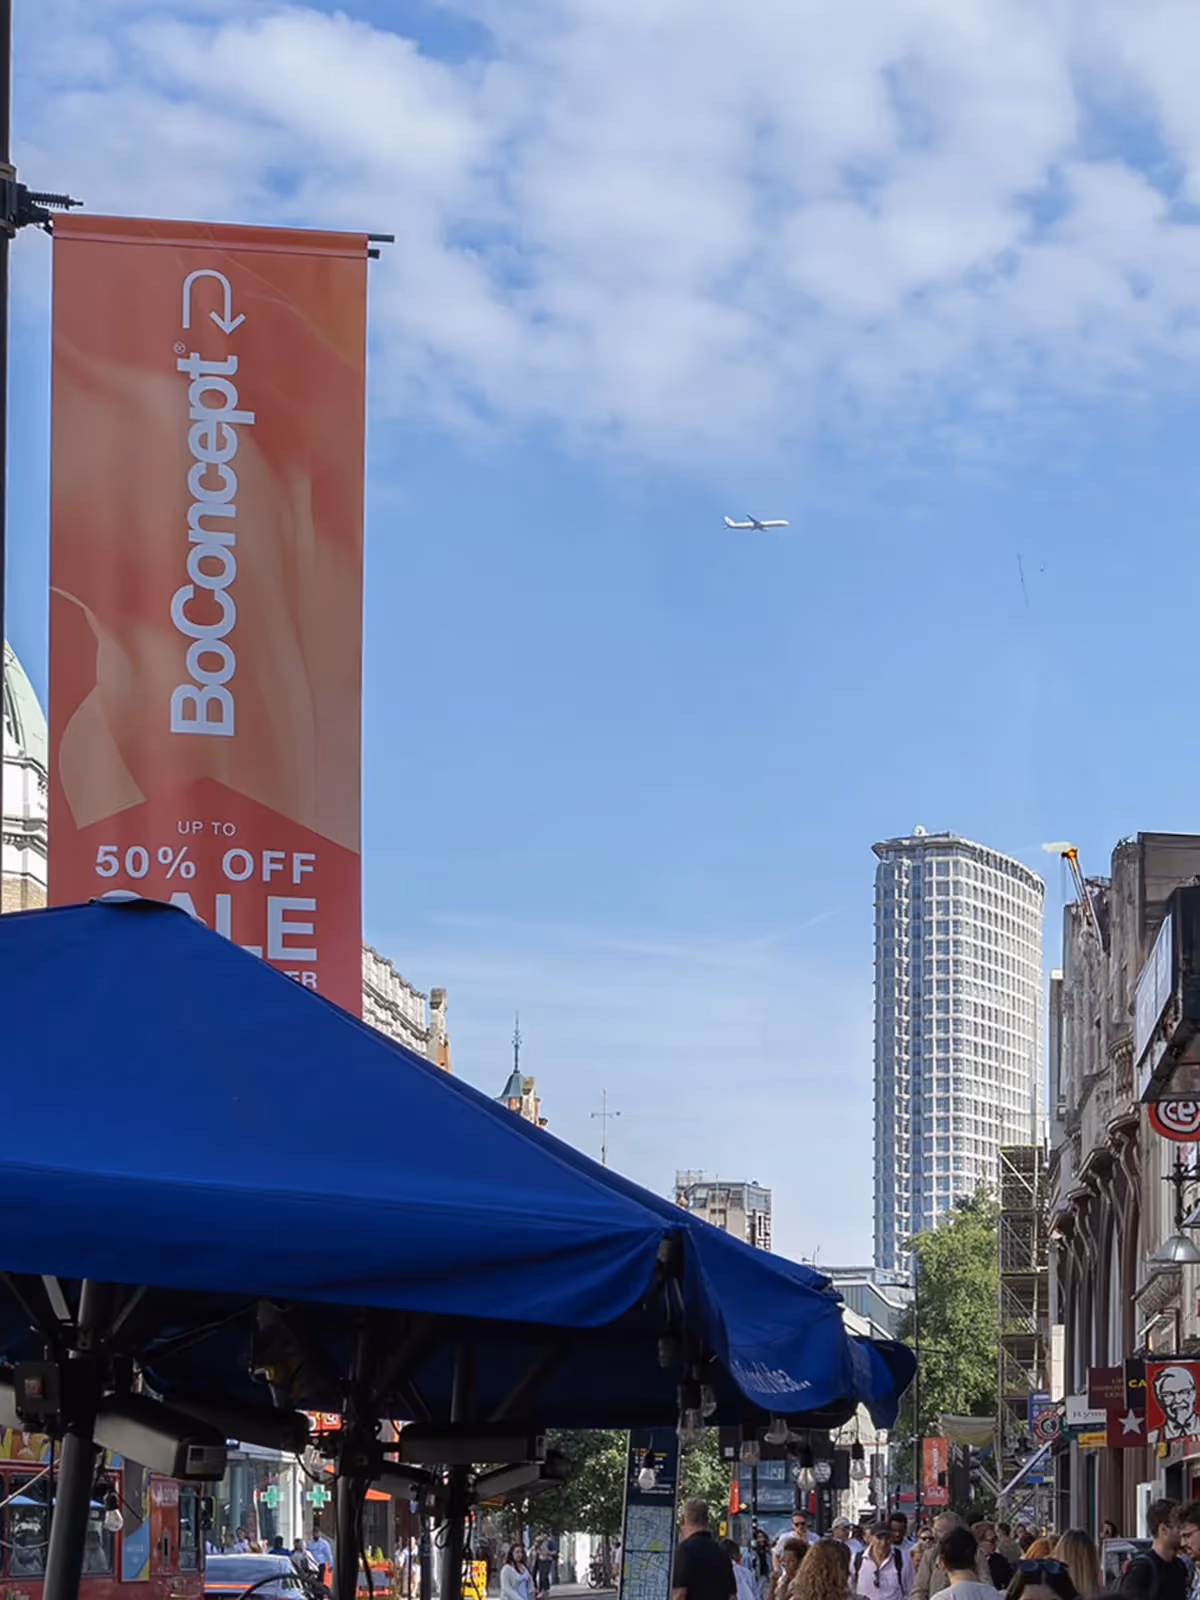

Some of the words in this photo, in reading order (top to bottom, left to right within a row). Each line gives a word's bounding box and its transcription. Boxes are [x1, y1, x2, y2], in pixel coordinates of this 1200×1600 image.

[177, 820, 203, 835] UP
[211, 821, 237, 837] TO
[94, 845, 196, 879] 50%
[222, 848, 316, 884] OFF
